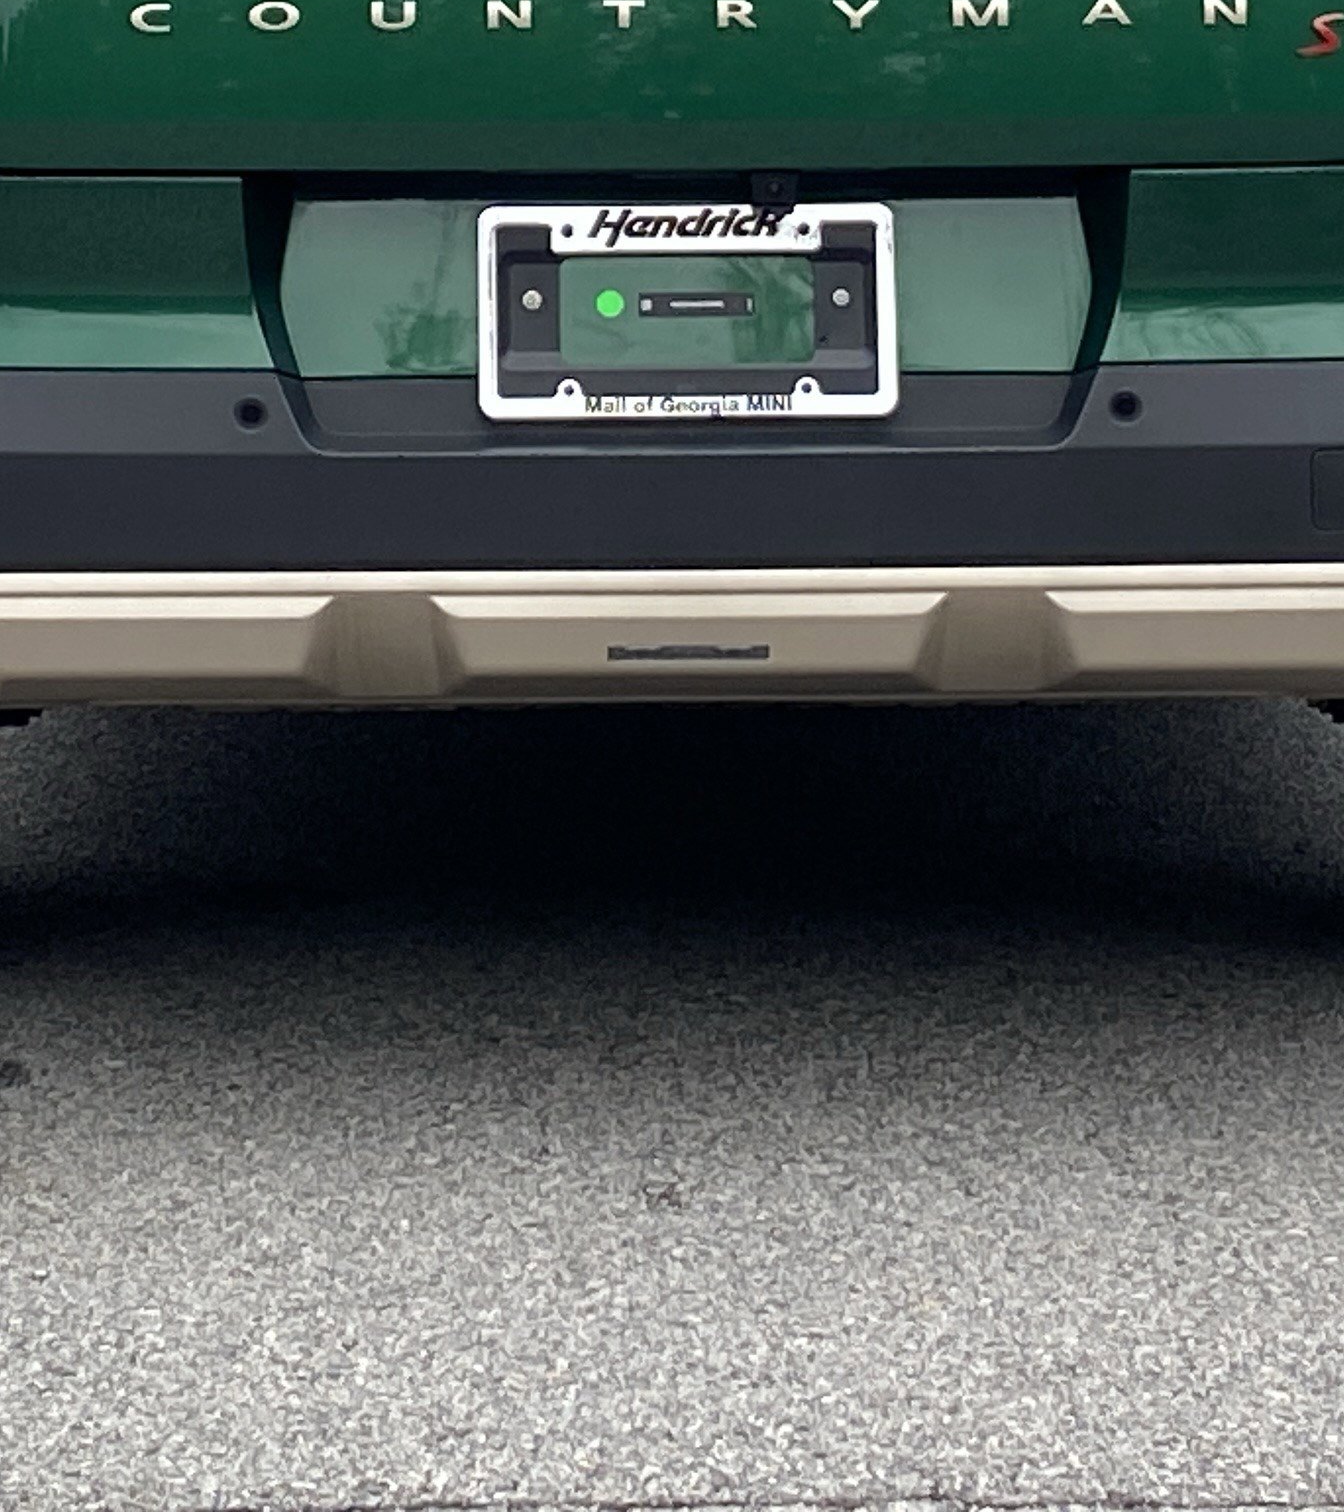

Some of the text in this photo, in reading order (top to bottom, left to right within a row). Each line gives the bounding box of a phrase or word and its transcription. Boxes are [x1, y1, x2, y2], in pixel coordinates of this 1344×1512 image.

[587, 208, 779, 248] Hendrick
[585, 395, 793, 417] Mall of Georgia MINI
